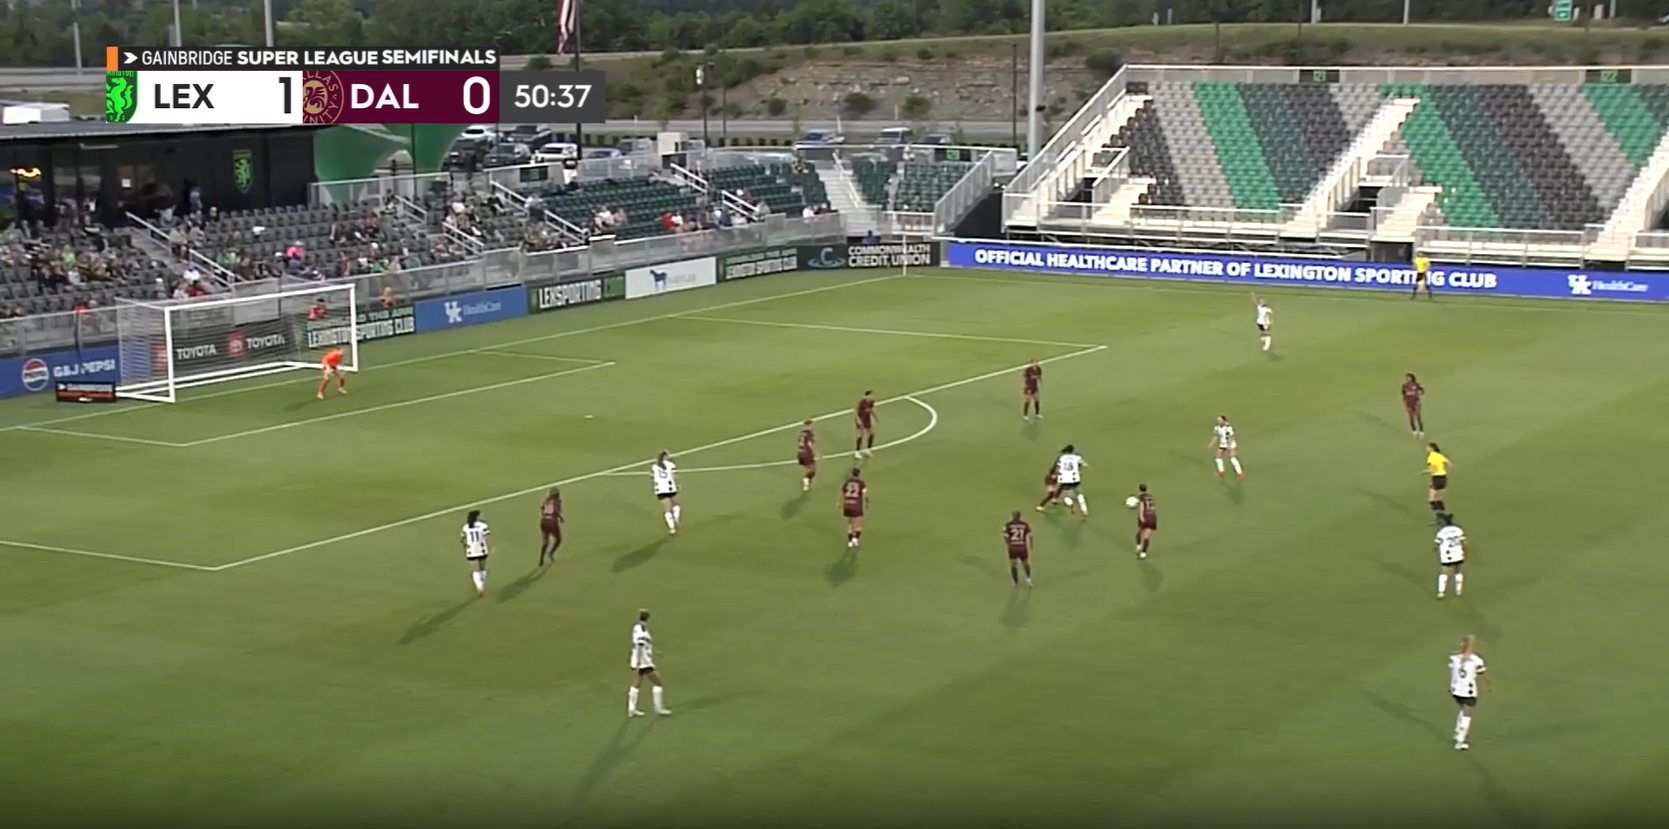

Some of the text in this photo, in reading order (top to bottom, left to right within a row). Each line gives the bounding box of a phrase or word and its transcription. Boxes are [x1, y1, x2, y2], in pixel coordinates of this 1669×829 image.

[848, 254, 931, 267] CREDIT UNION
[975, 249, 1044, 267] OFFICIAL
[1047, 253, 1147, 272] HEALTHCARE
[1151, 257, 1223, 276] PARTNER
[1226, 261, 1251, 277] OF
[1253, 263, 1350, 282] LEXINGTON
[1449, 273, 1498, 288] CLUB
[246, 334, 285, 349] TOYOTA
[176, 344, 217, 360] TOYOTA
[845, 482, 859, 498] 22
[469, 530, 479, 543] 11
[1010, 528, 1024, 541] 21
